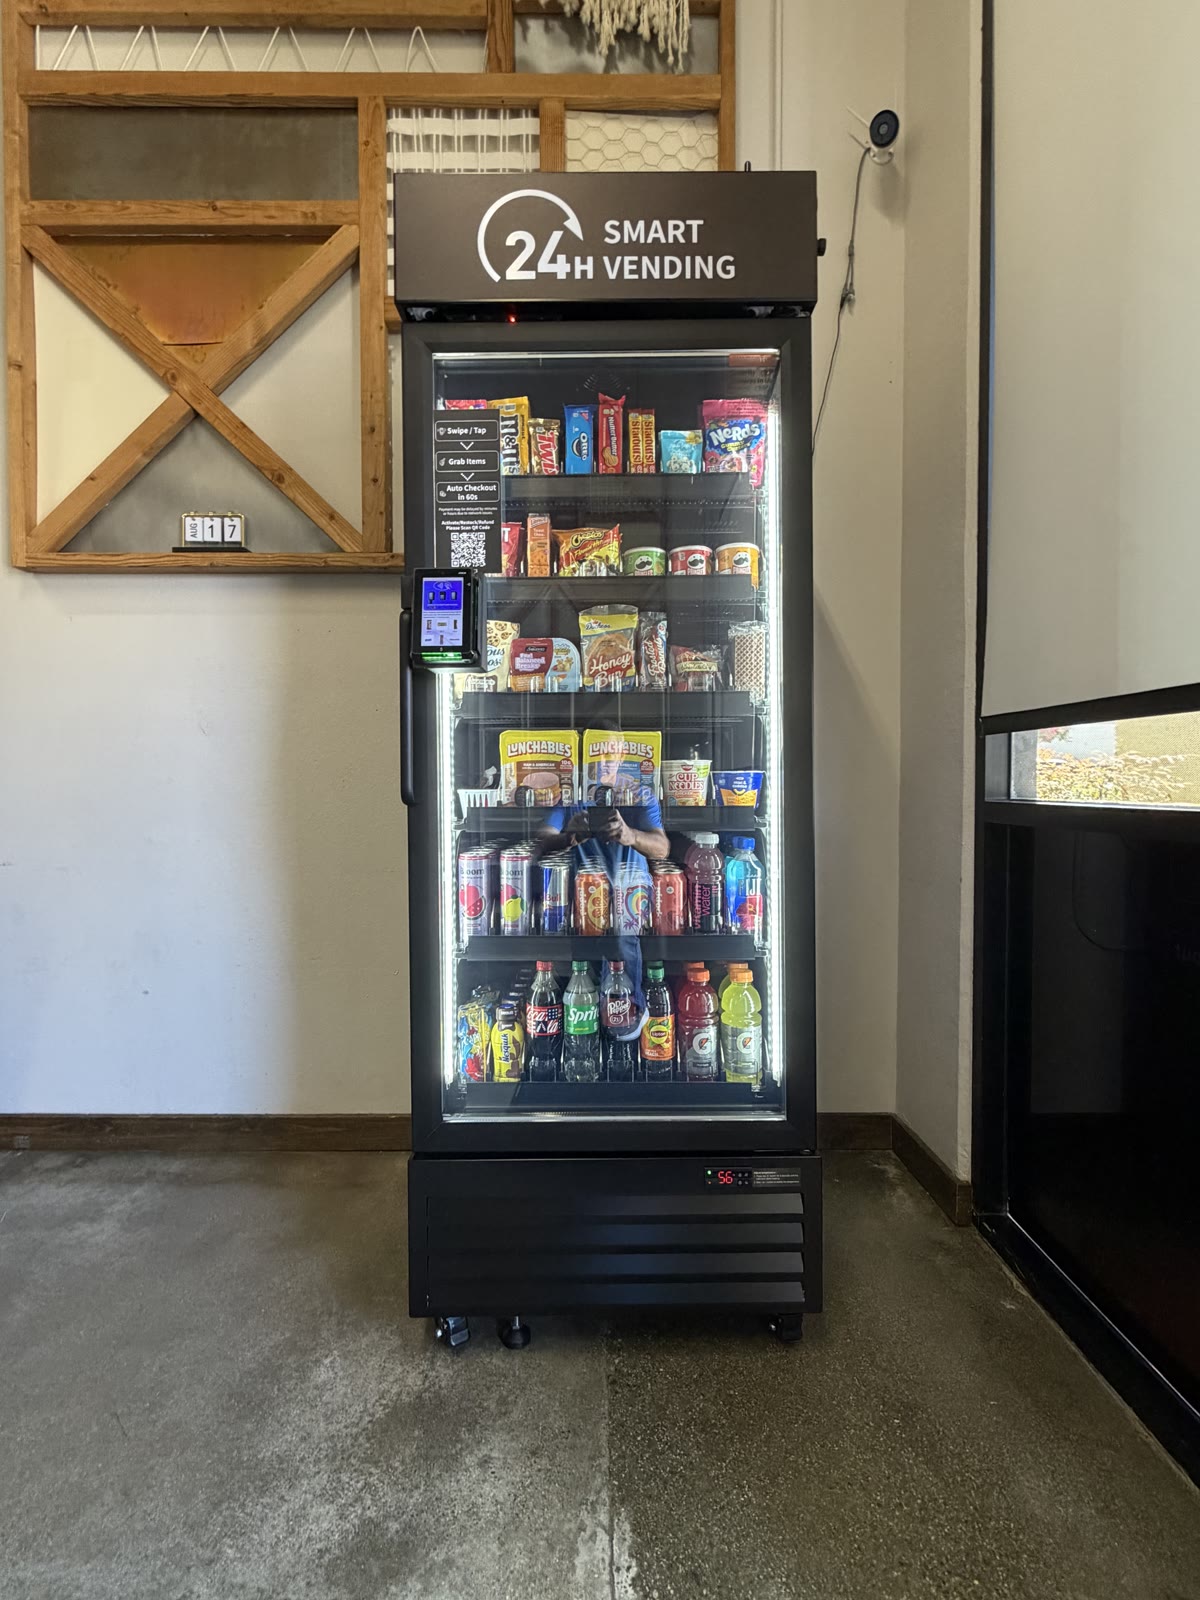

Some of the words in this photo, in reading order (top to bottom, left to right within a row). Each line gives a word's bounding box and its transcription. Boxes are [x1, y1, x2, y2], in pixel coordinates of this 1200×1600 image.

[603, 219, 705, 244] SMART
[602, 255, 736, 280] VENDING
[447, 427, 469, 435] Swipe
[473, 427, 487, 435] Tap
[580, 432, 588, 461] OREO
[189, 523, 198, 538] AUG
[208, 524, 214, 538] 1
[228, 524, 237, 538] 7
[589, 653, 631, 675] Honey
[594, 669, 624, 688] Bun
[669, 781, 704, 791] NOODLES
[676, 772, 699, 782] CUP
[702, 885, 711, 916] water
